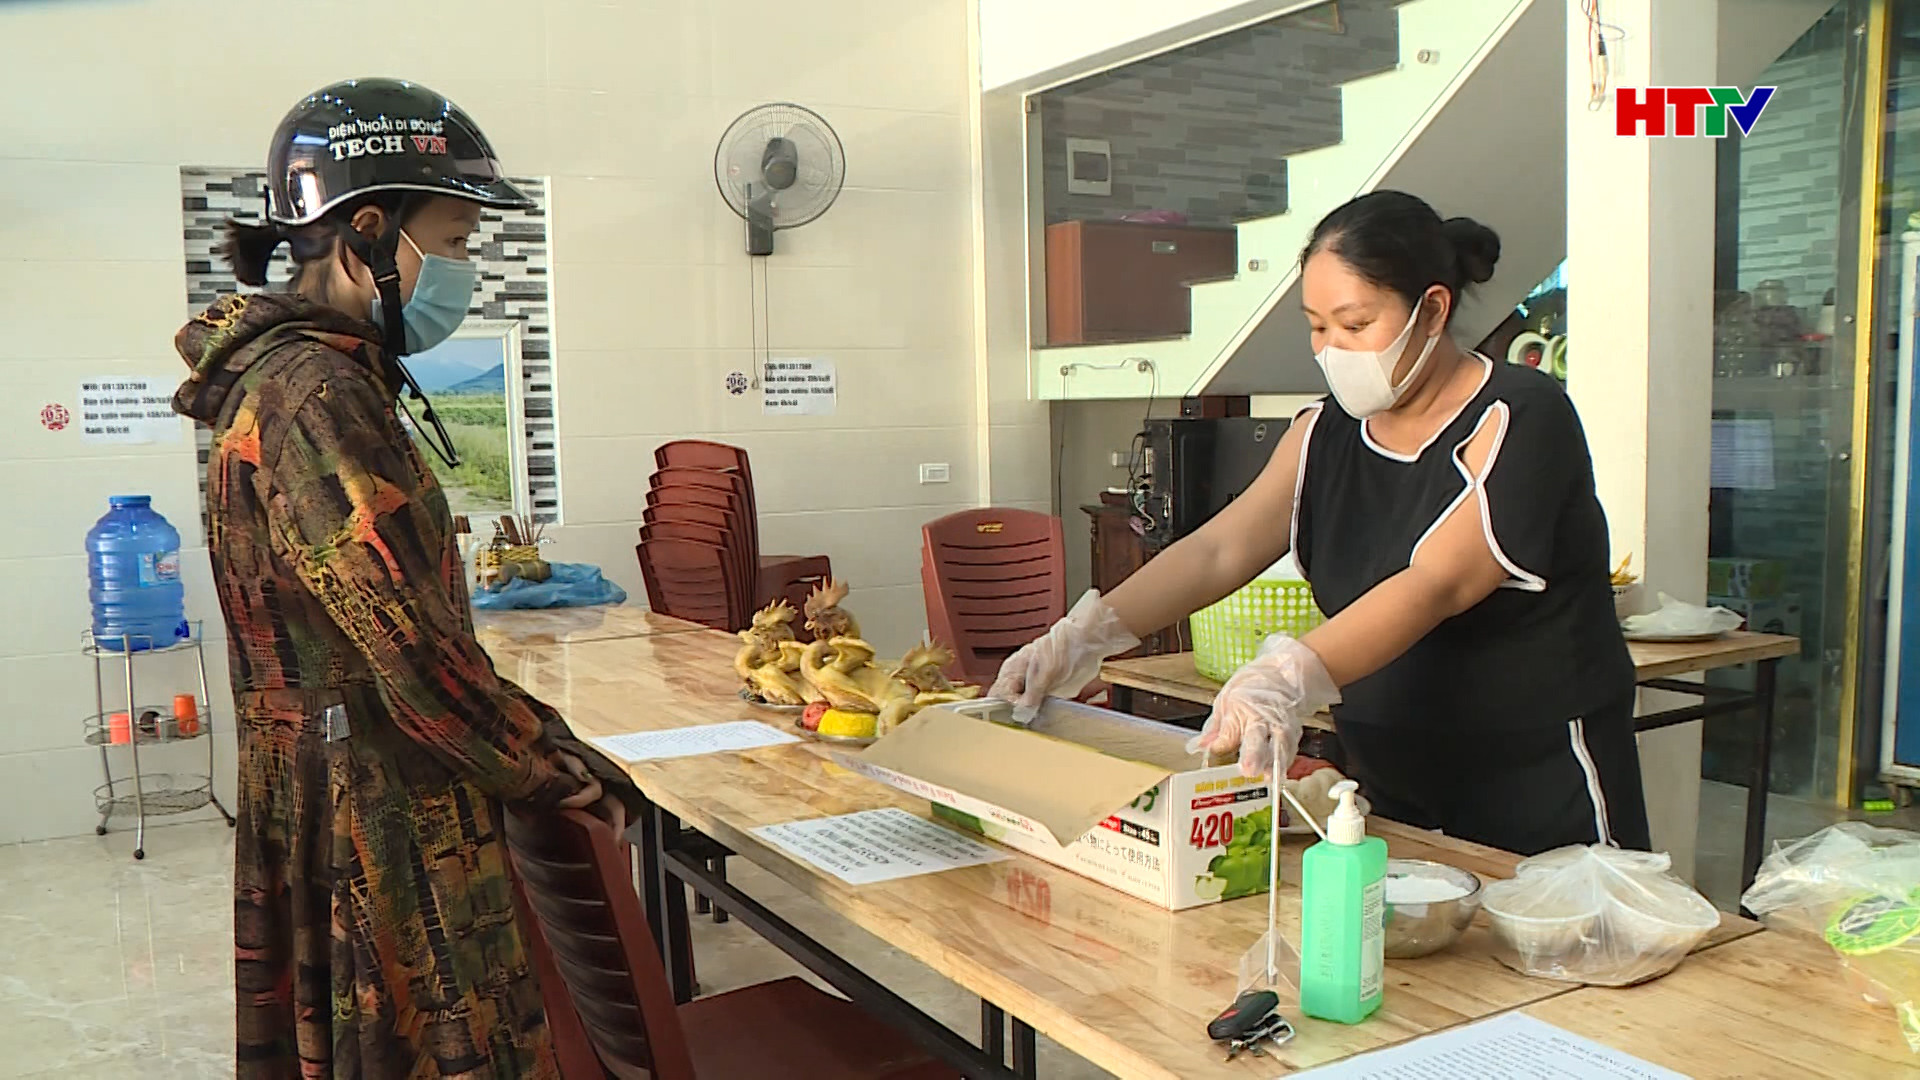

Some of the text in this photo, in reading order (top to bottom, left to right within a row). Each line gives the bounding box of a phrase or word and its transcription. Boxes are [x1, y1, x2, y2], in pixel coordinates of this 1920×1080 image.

[395, 119, 408, 132] DI
[329, 134, 447, 161] TECH VN
[1190, 811, 1234, 850] 420
